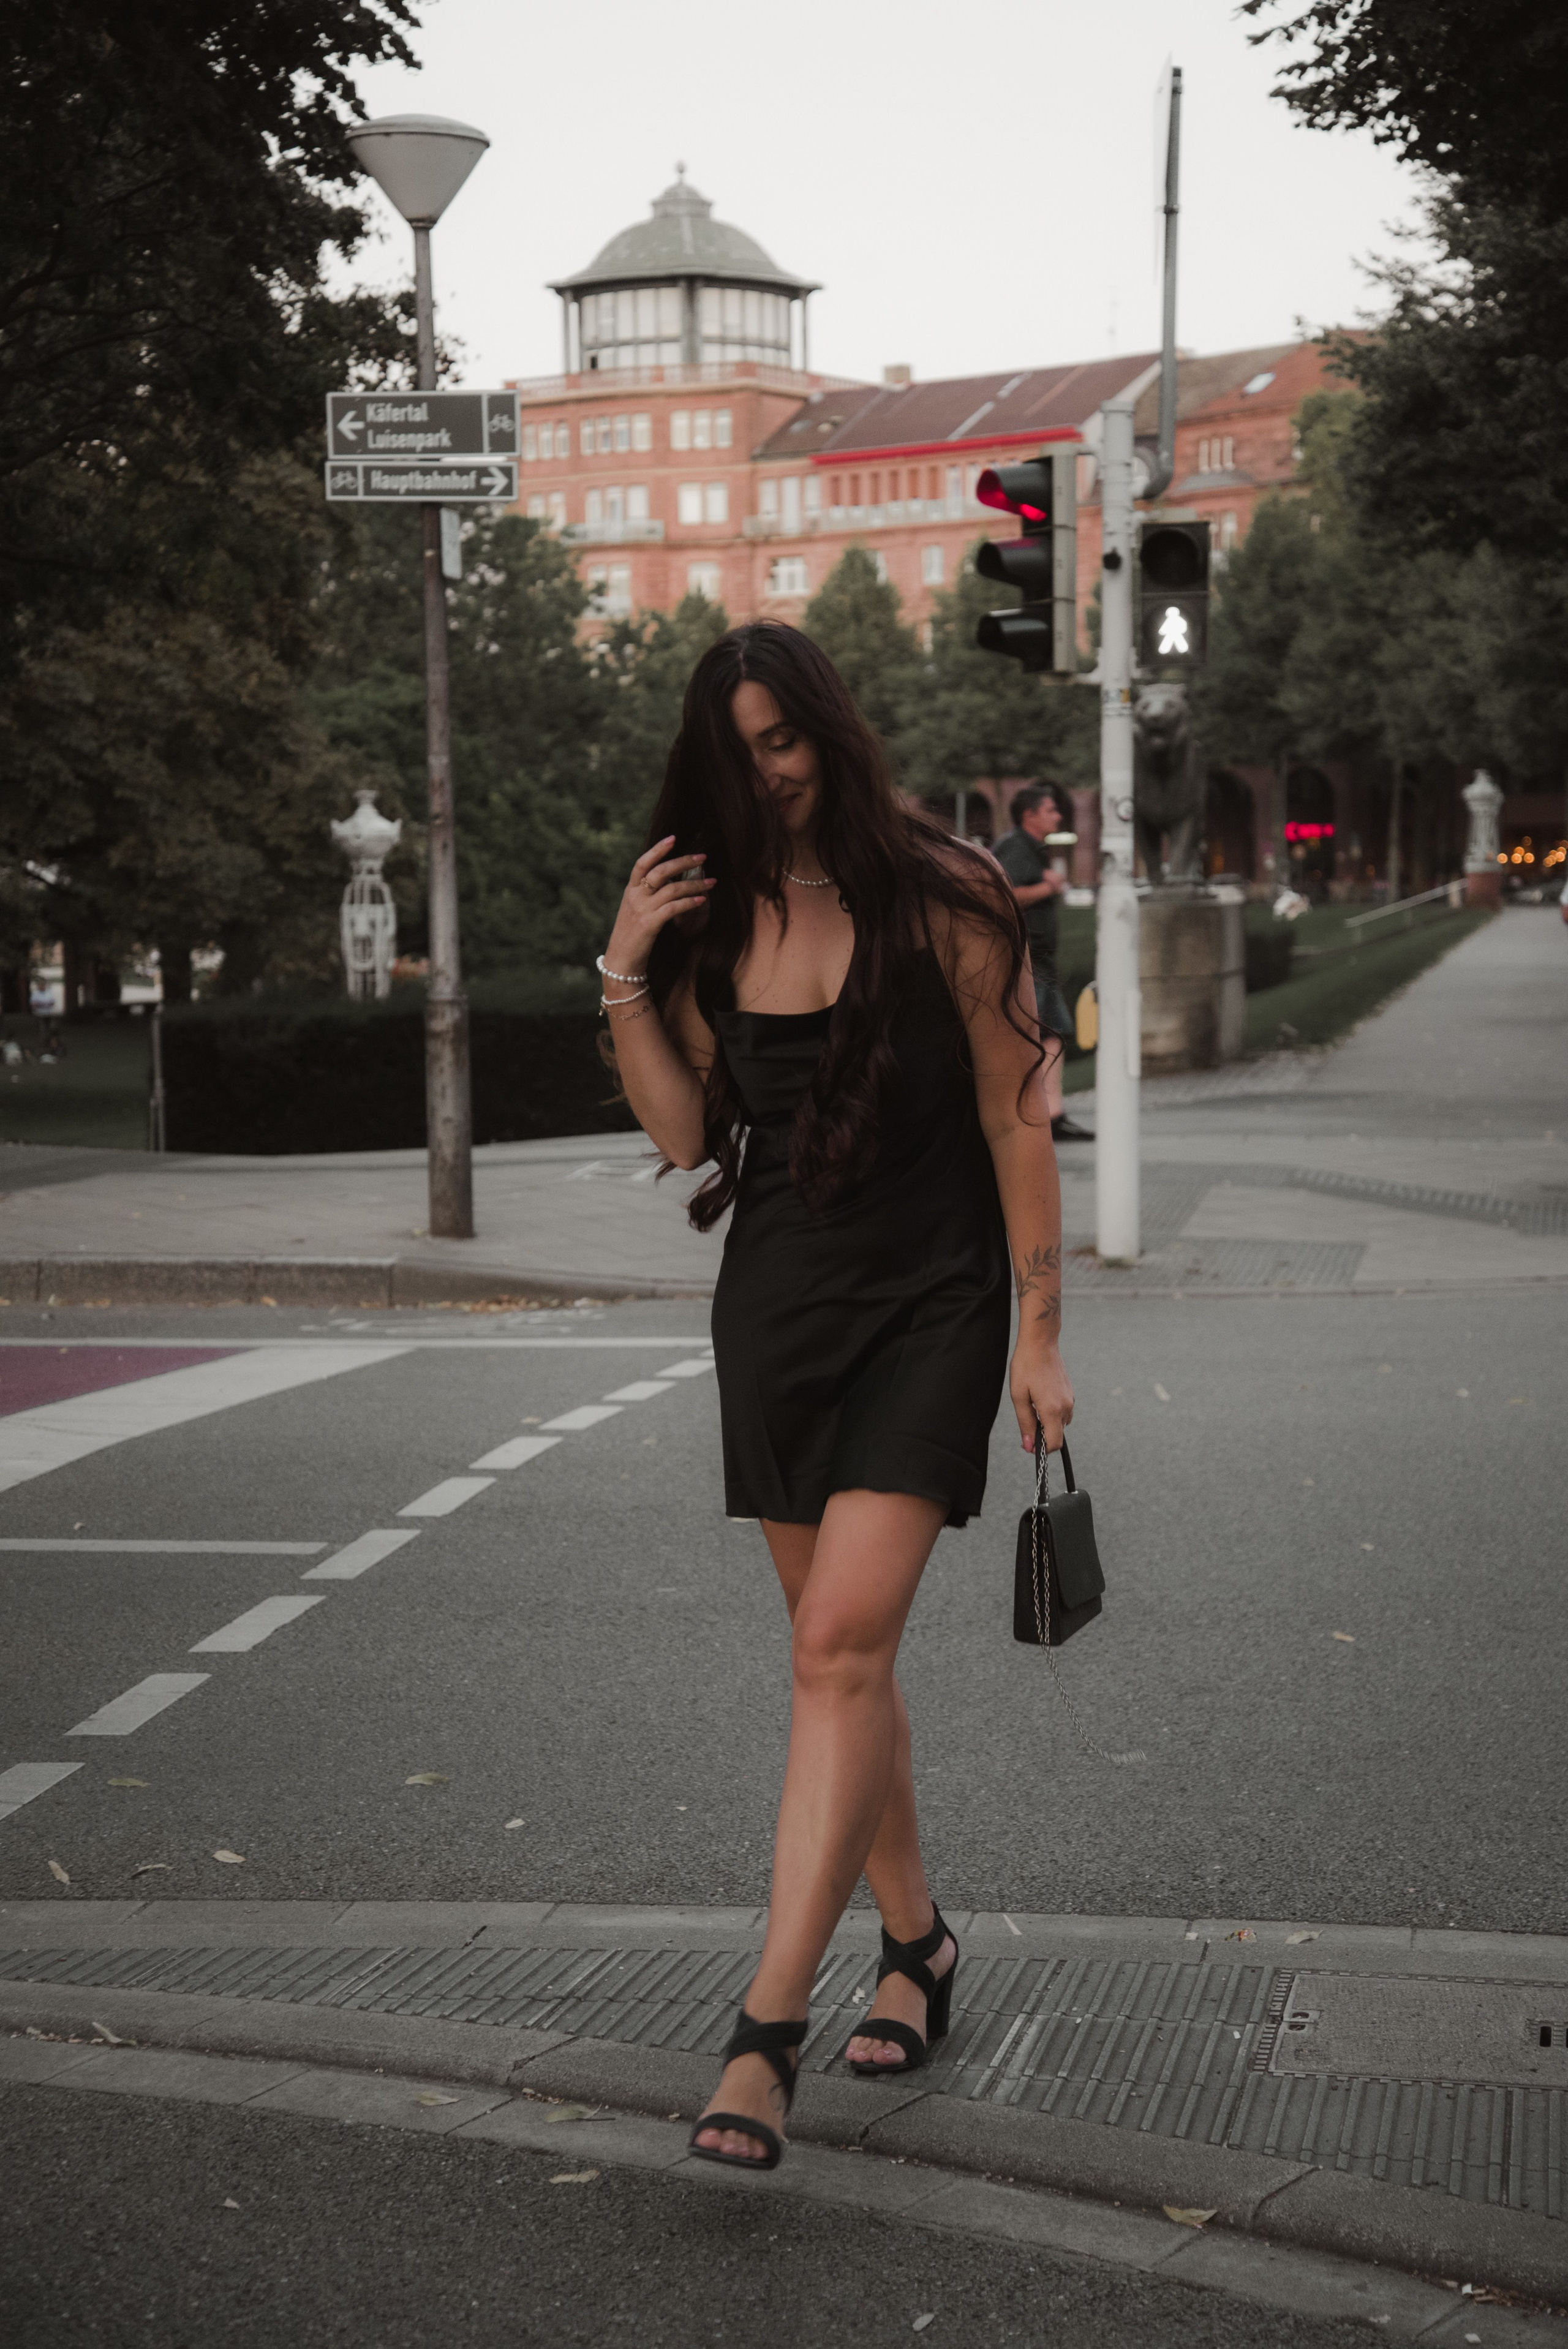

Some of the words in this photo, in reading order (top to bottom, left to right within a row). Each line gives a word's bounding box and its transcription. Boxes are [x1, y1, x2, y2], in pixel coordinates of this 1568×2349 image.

[367, 402, 428, 422] Käfertal
[368, 429, 451, 452] Luisenpark
[371, 470, 477, 494] Hauptbahnhof
